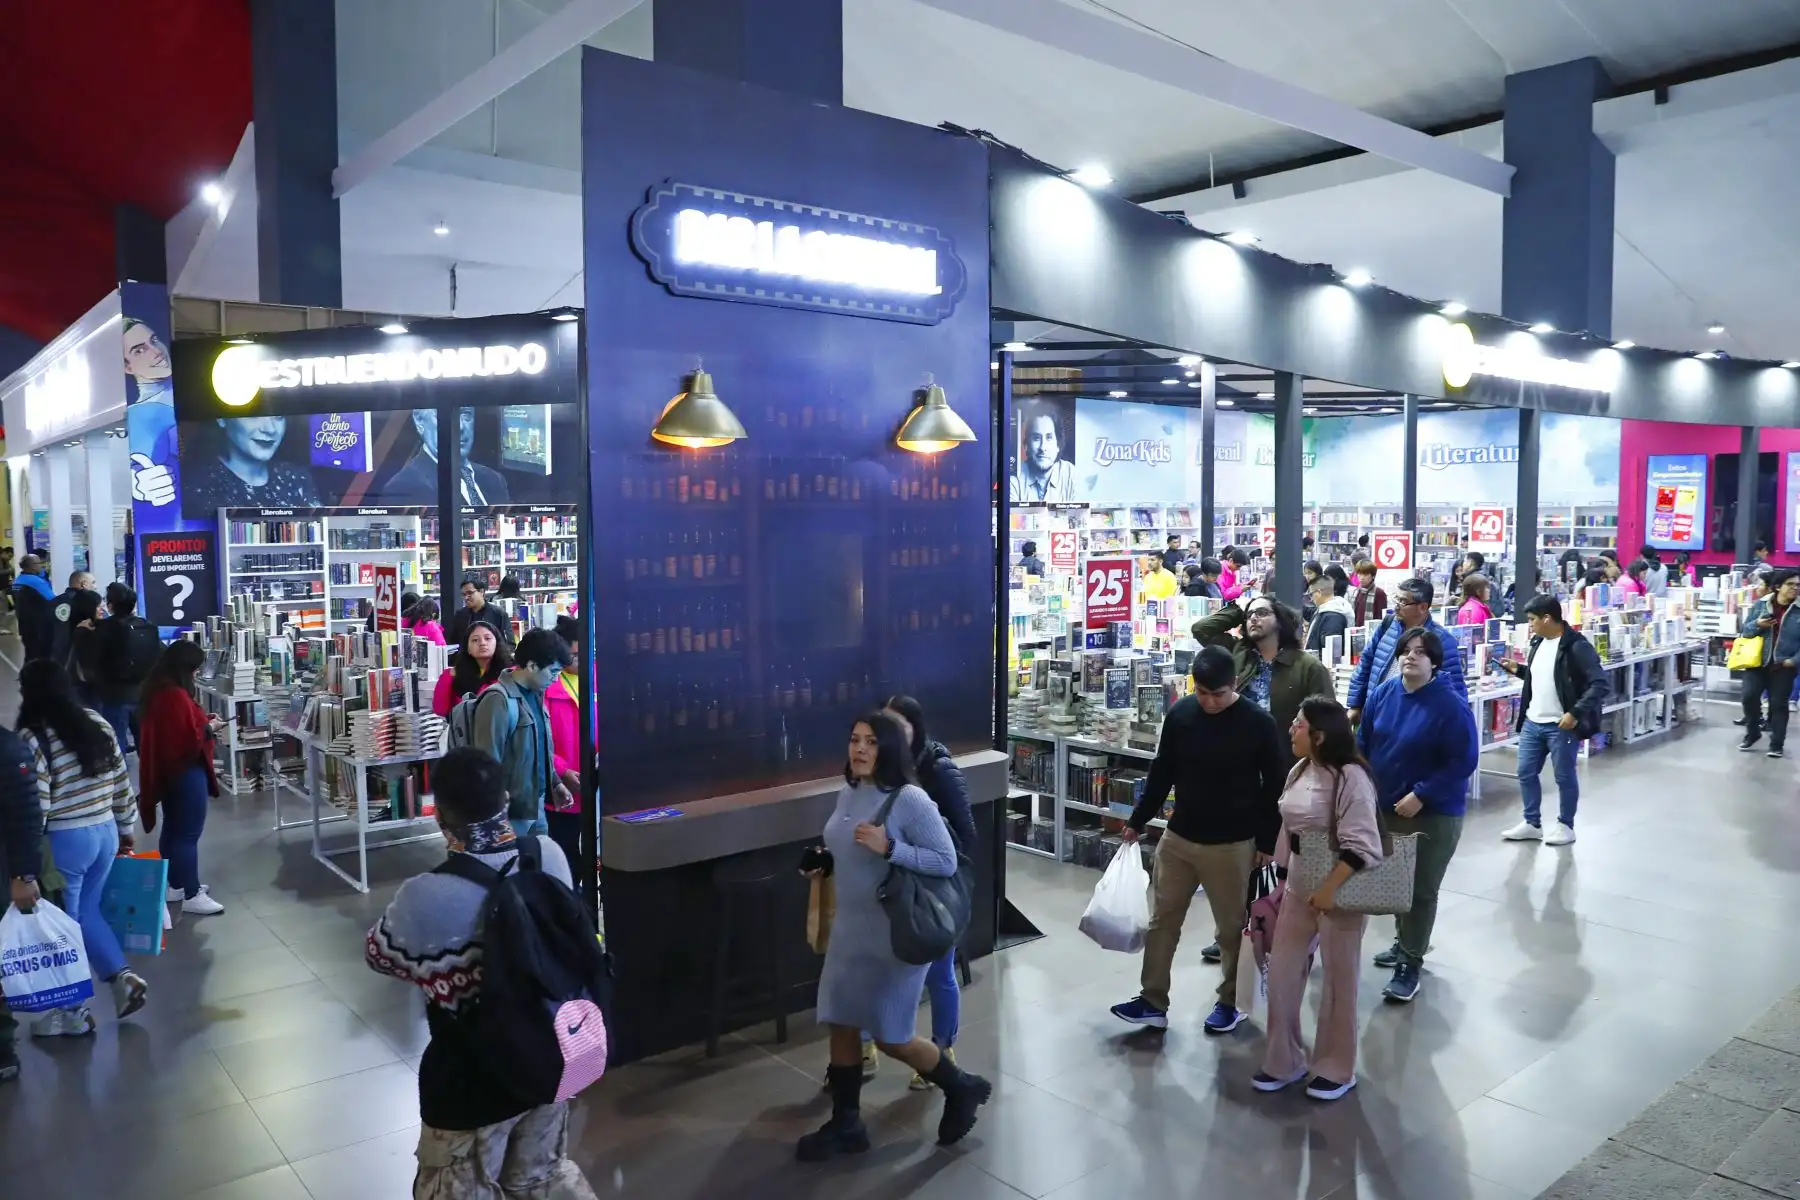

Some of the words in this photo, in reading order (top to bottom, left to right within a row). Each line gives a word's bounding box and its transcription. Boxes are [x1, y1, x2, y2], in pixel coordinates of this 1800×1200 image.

[322, 421, 350, 431] Cuento
[315, 431, 359, 452] Perfecto
[1094, 437, 1132, 466] Zona
[1132, 439, 1171, 466] Kids
[1473, 515, 1502, 535] 40
[1054, 533, 1075, 554] 25
[152, 554, 203, 563] DEVELAREMOS
[1384, 547, 1395, 562] 9
[166, 563, 205, 571] IMPORTANTE
[164, 574, 194, 620] ?
